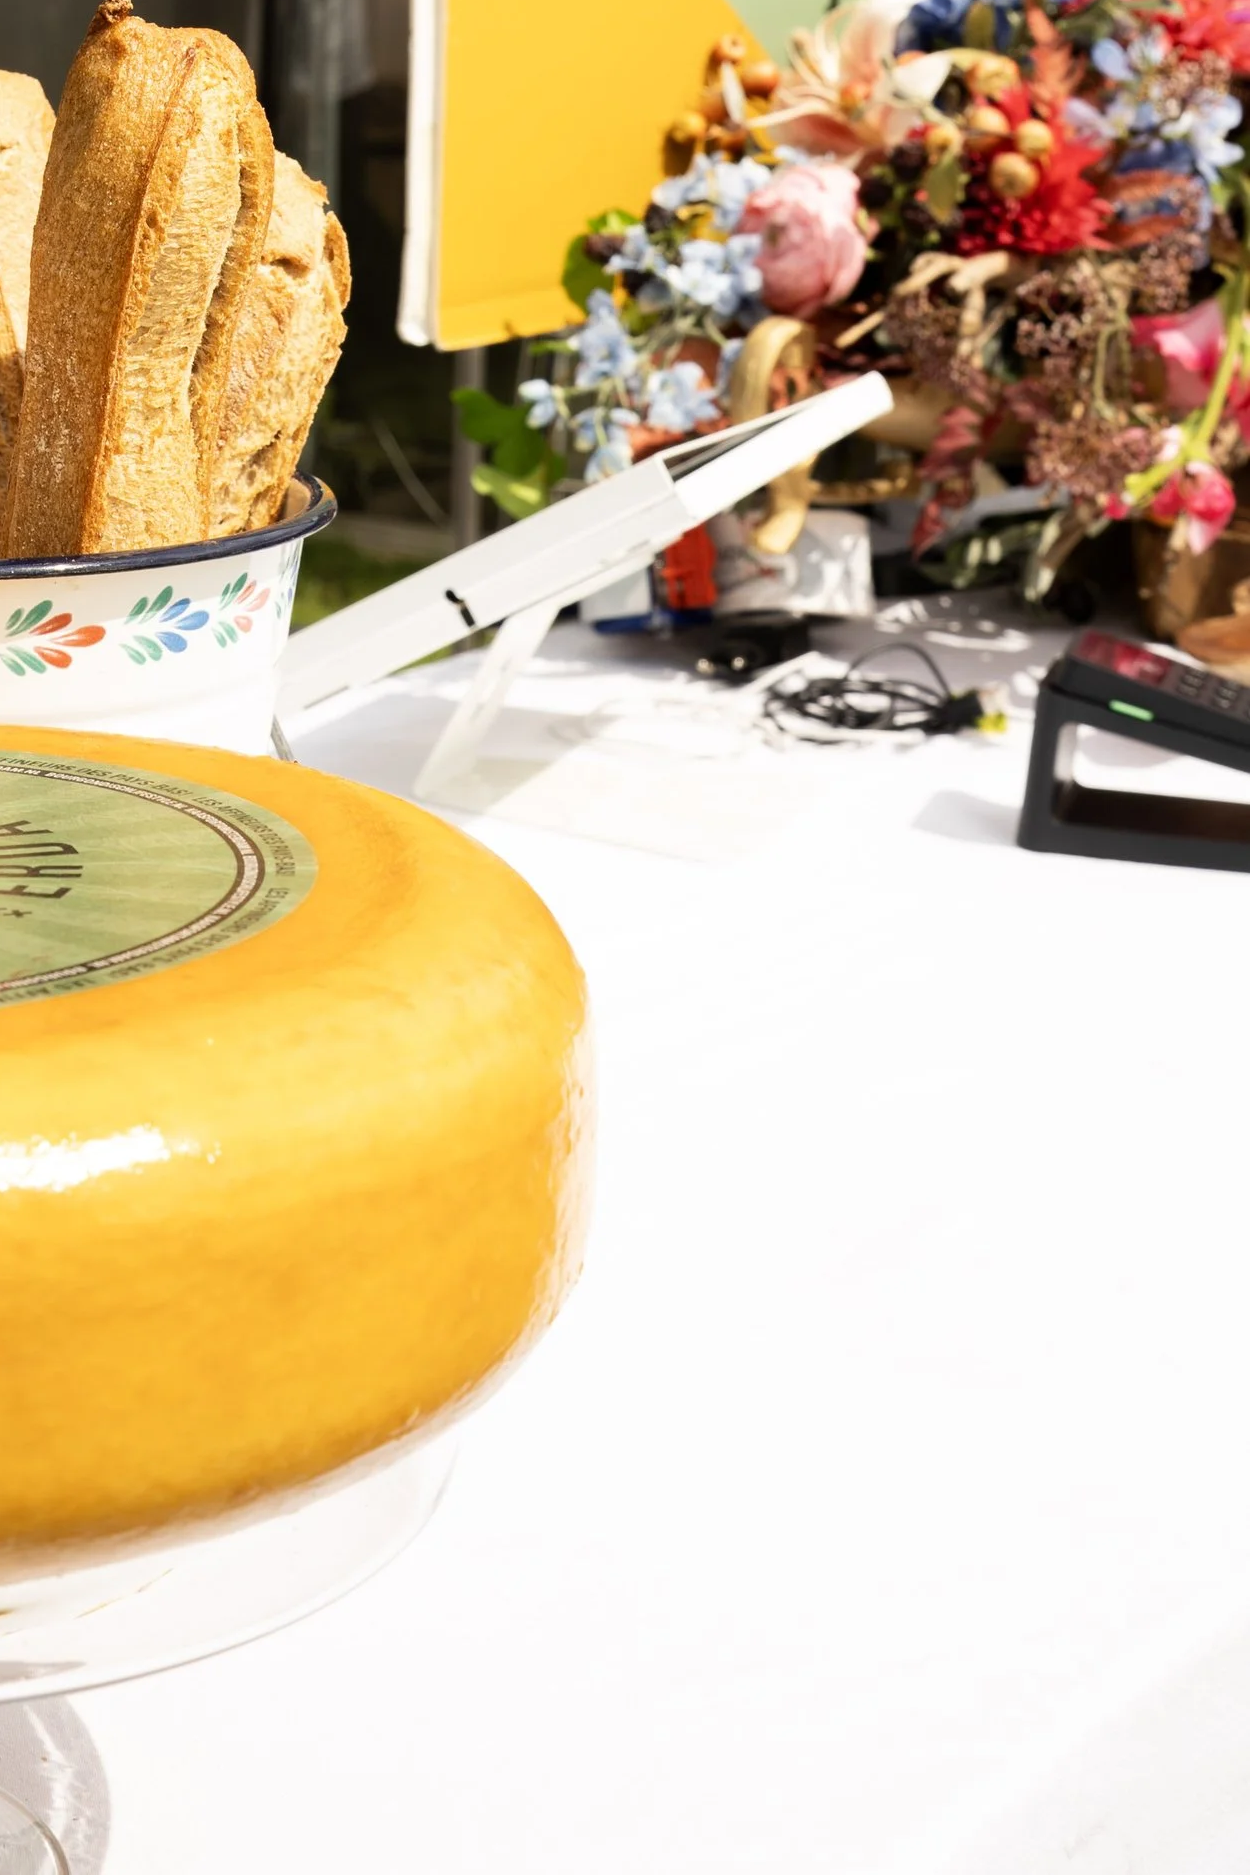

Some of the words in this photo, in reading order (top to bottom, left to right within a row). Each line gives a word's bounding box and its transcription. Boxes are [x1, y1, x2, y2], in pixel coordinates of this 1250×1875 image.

[75, 767, 112, 777] DES
[109, 773, 191, 795] PAYS-BAS!
[191, 795, 223, 807] LES
